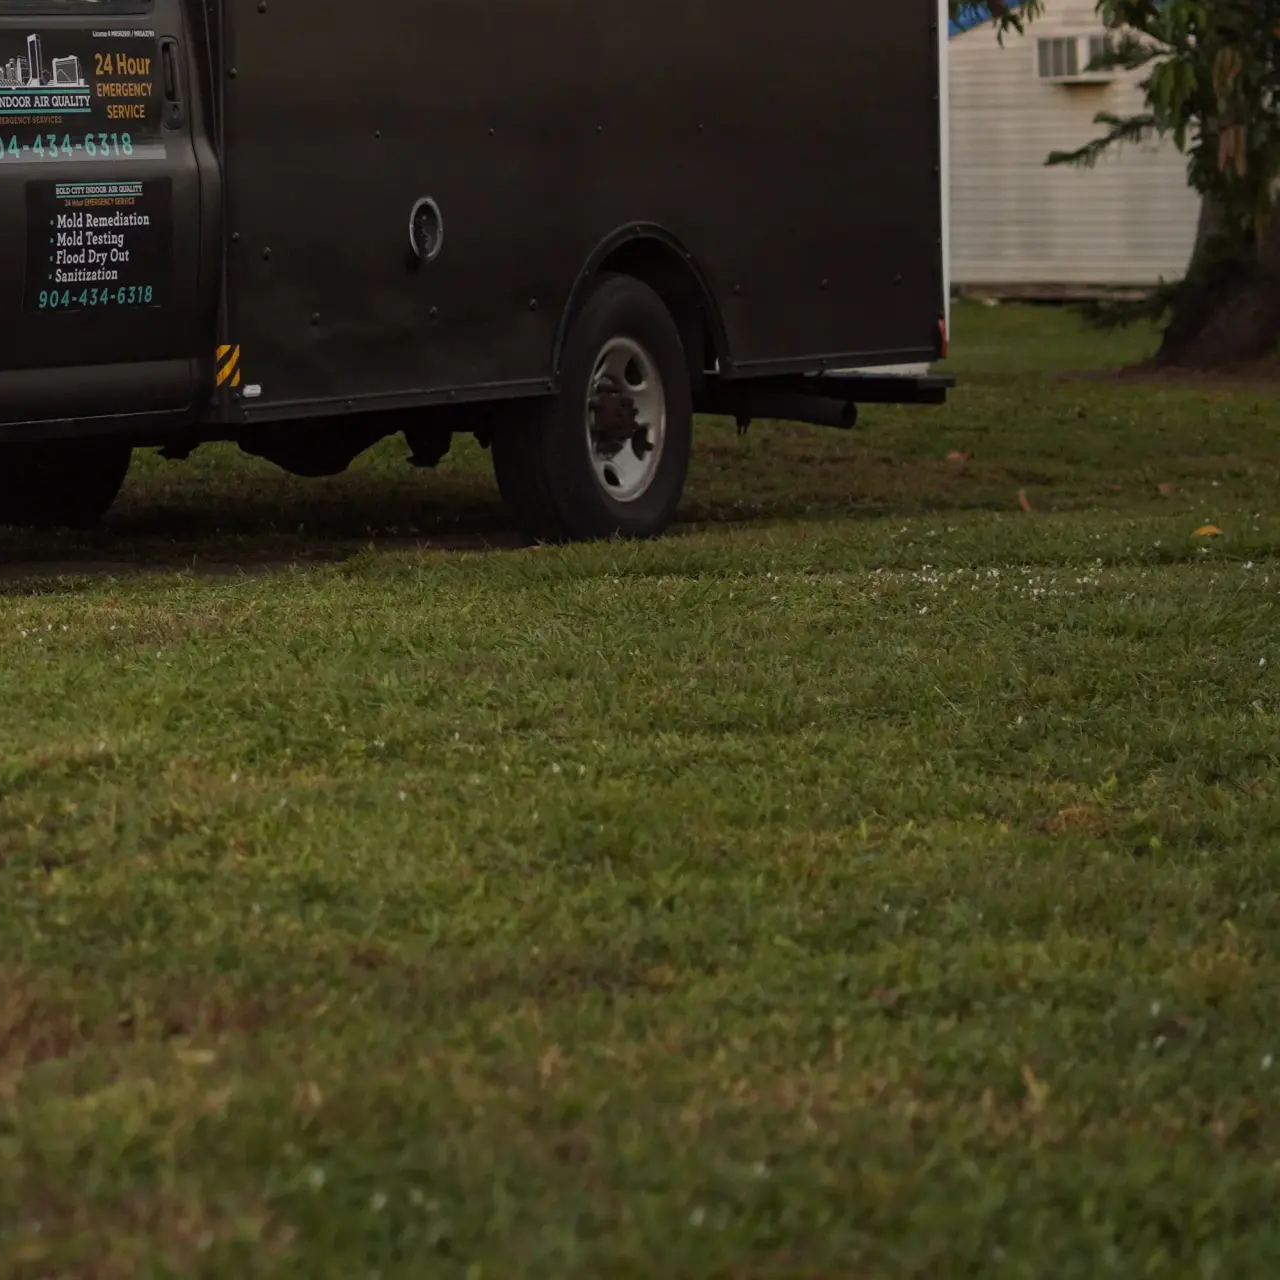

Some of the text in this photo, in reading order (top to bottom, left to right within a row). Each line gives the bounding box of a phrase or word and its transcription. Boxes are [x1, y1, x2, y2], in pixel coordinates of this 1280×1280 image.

[95, 53, 151, 75] 24 Hour
[96, 82, 152, 97] EMERGENCY
[34, 96, 50, 107] AIR
[51, 95, 90, 108] QUALITY
[107, 104, 145, 118] SERVICE
[32, 115, 63, 124] SERVICES
[55, 184, 143, 195] BOLD CITY INDOOR AIR QUALITY
[56, 211, 149, 228] Mold Remediation
[56, 231, 124, 247] Mold Testing
[56, 248, 130, 266] Flood Dry Out
[55, 268, 118, 283] Sanitization
[39, 285, 153, 308] 904-434-6318
